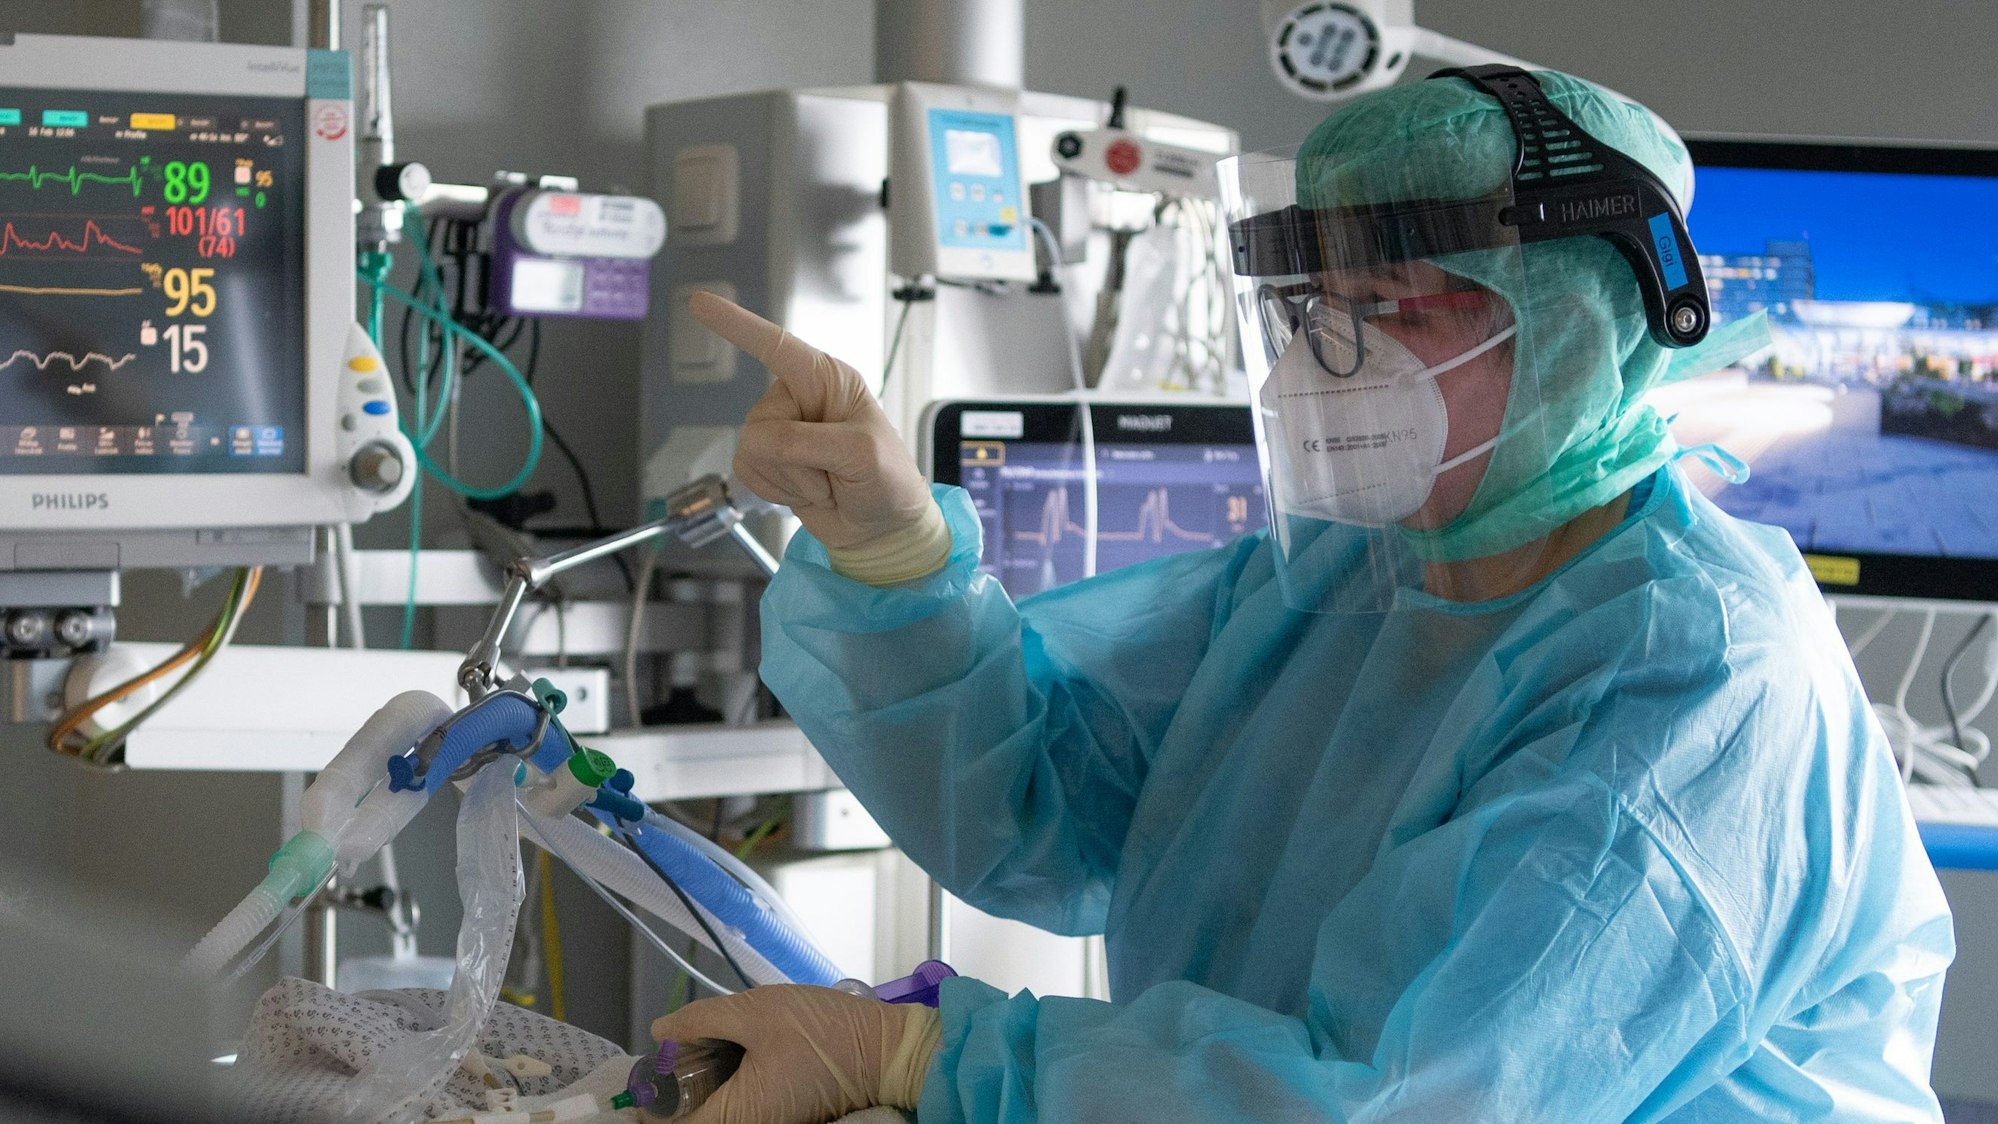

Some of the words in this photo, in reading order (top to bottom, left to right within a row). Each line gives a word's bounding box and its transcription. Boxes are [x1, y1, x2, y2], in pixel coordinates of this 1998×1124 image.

[163, 161, 211, 204] 89
[165, 206, 246, 237] 101/61
[1562, 195, 1635, 222] HAIMER
[198, 235, 237, 259] (74)
[1658, 236, 1675, 267] Gigi
[163, 267, 217, 318] 95
[163, 324, 209, 373] 15
[1303, 440, 1320, 453] CE
[1385, 428, 1417, 443] KN95
[32, 493, 109, 510] PHILIPS
